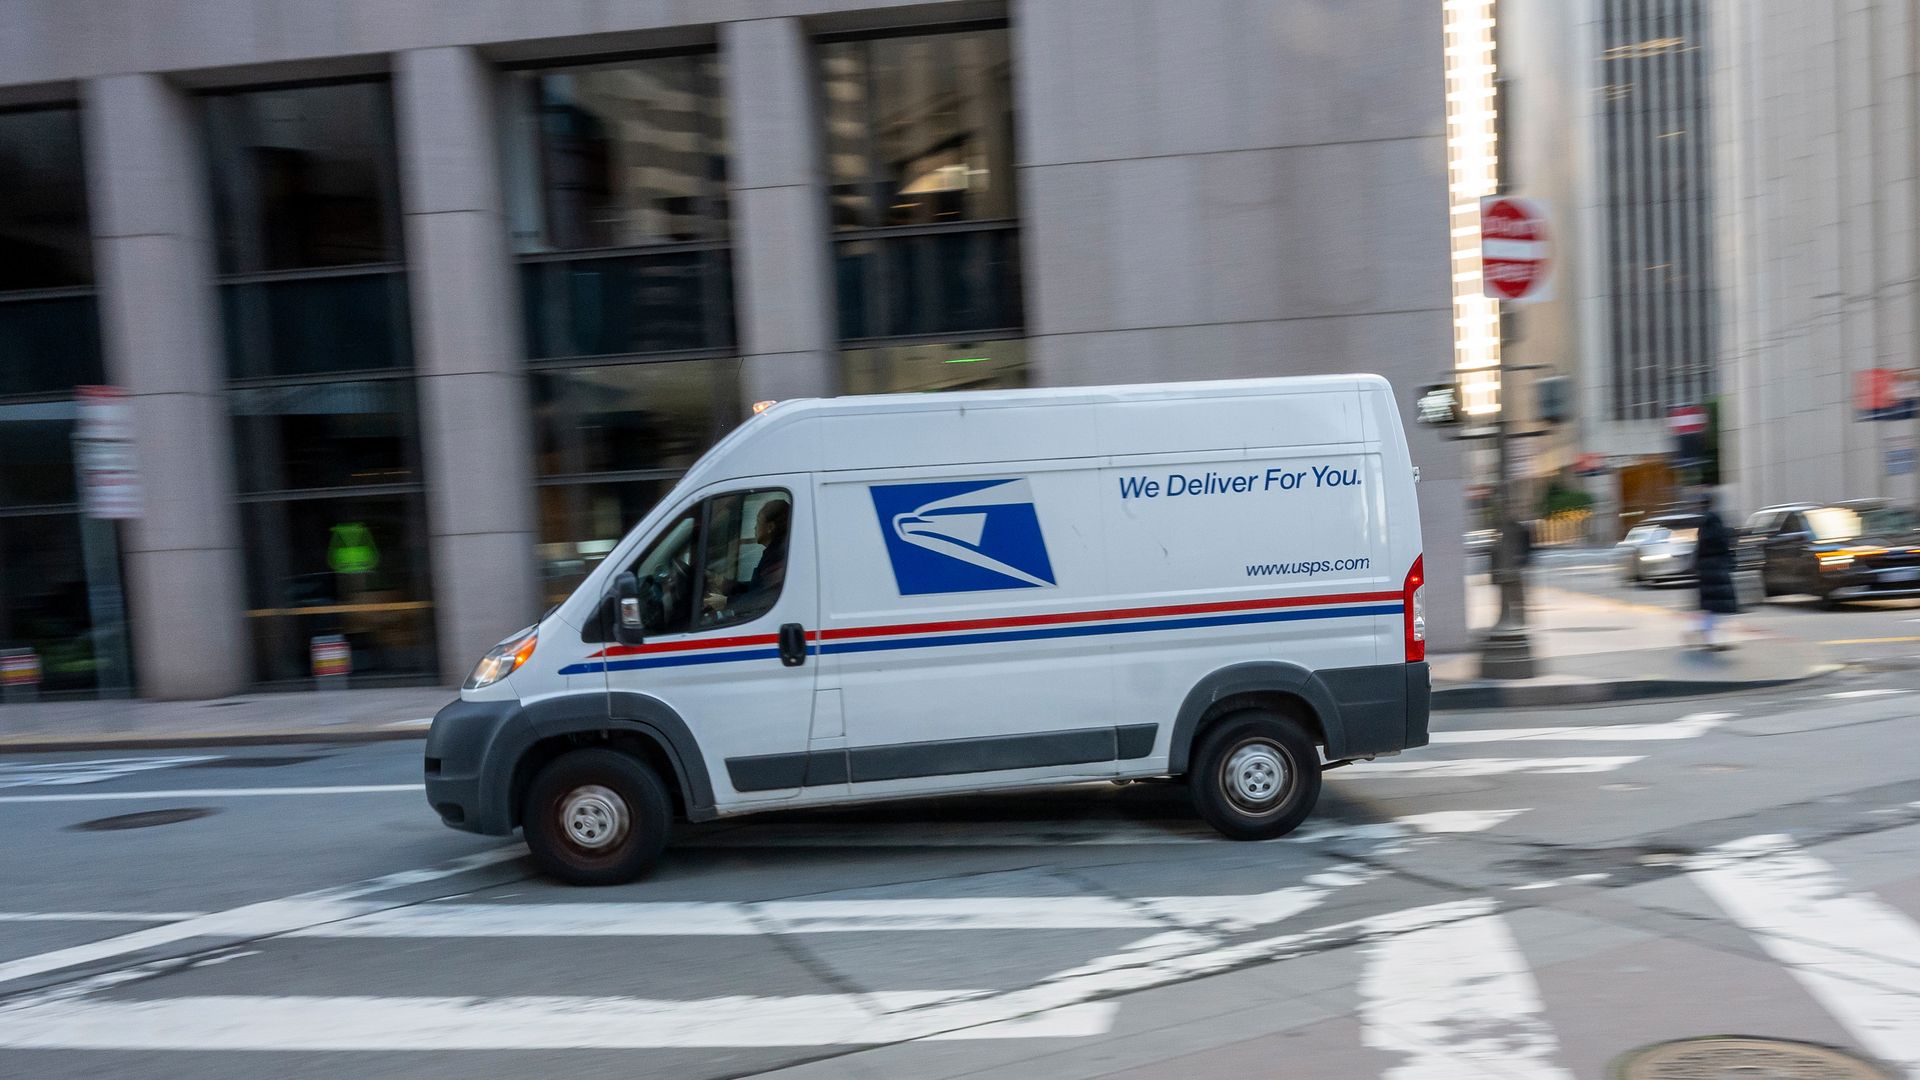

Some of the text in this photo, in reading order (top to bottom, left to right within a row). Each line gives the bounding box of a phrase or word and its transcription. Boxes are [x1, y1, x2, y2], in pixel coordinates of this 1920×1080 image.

[1119, 465, 1362, 499] We Deliver For You.
[1246, 558, 1370, 577] www.usps.com
